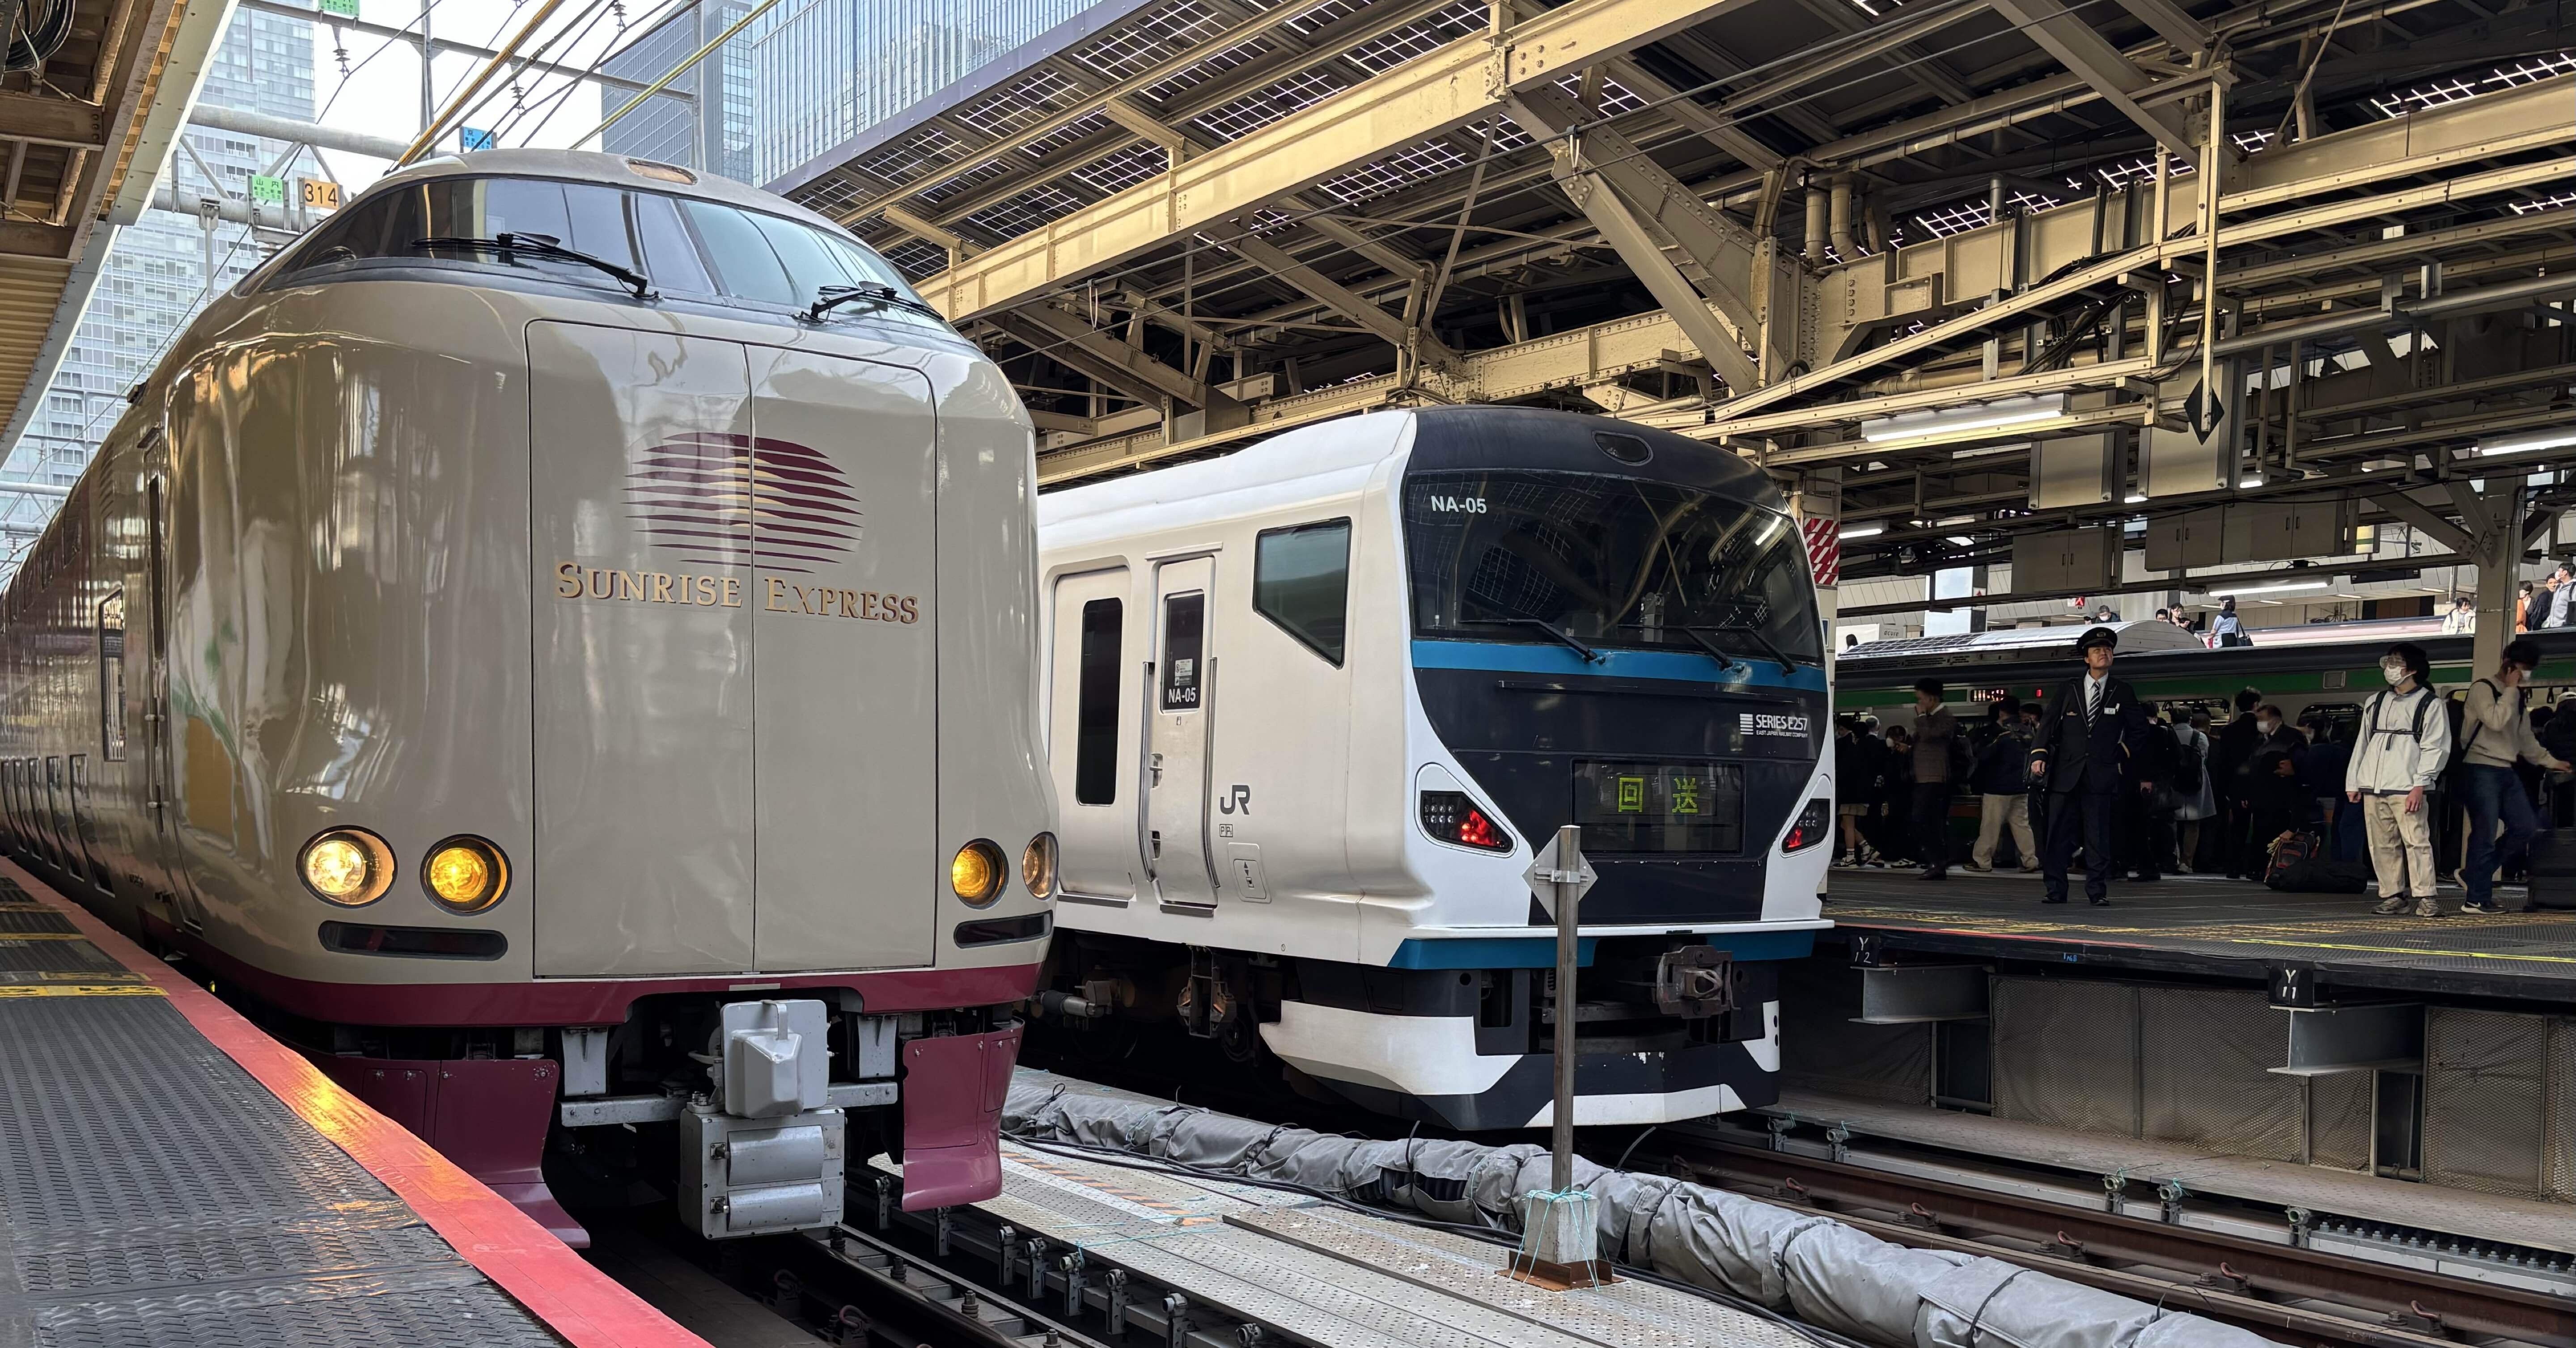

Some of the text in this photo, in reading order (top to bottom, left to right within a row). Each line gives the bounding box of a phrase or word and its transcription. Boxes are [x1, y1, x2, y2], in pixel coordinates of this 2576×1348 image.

[305, 183, 337, 207] 314
[1431, 495, 1487, 514] NA-05
[555, 561, 919, 625] SUNRISE EXPRESS
[1168, 687, 1196, 704] NA-05
[1756, 714, 1808, 731] SERIES E257
[1220, 785, 1250, 815] JR
[1618, 777, 1698, 813] 回送
[1859, 937, 1868, 951] Y
[1855, 951, 1872, 963] 12
[2285, 969, 2296, 984] Y
[2282, 986, 2296, 999] 11
